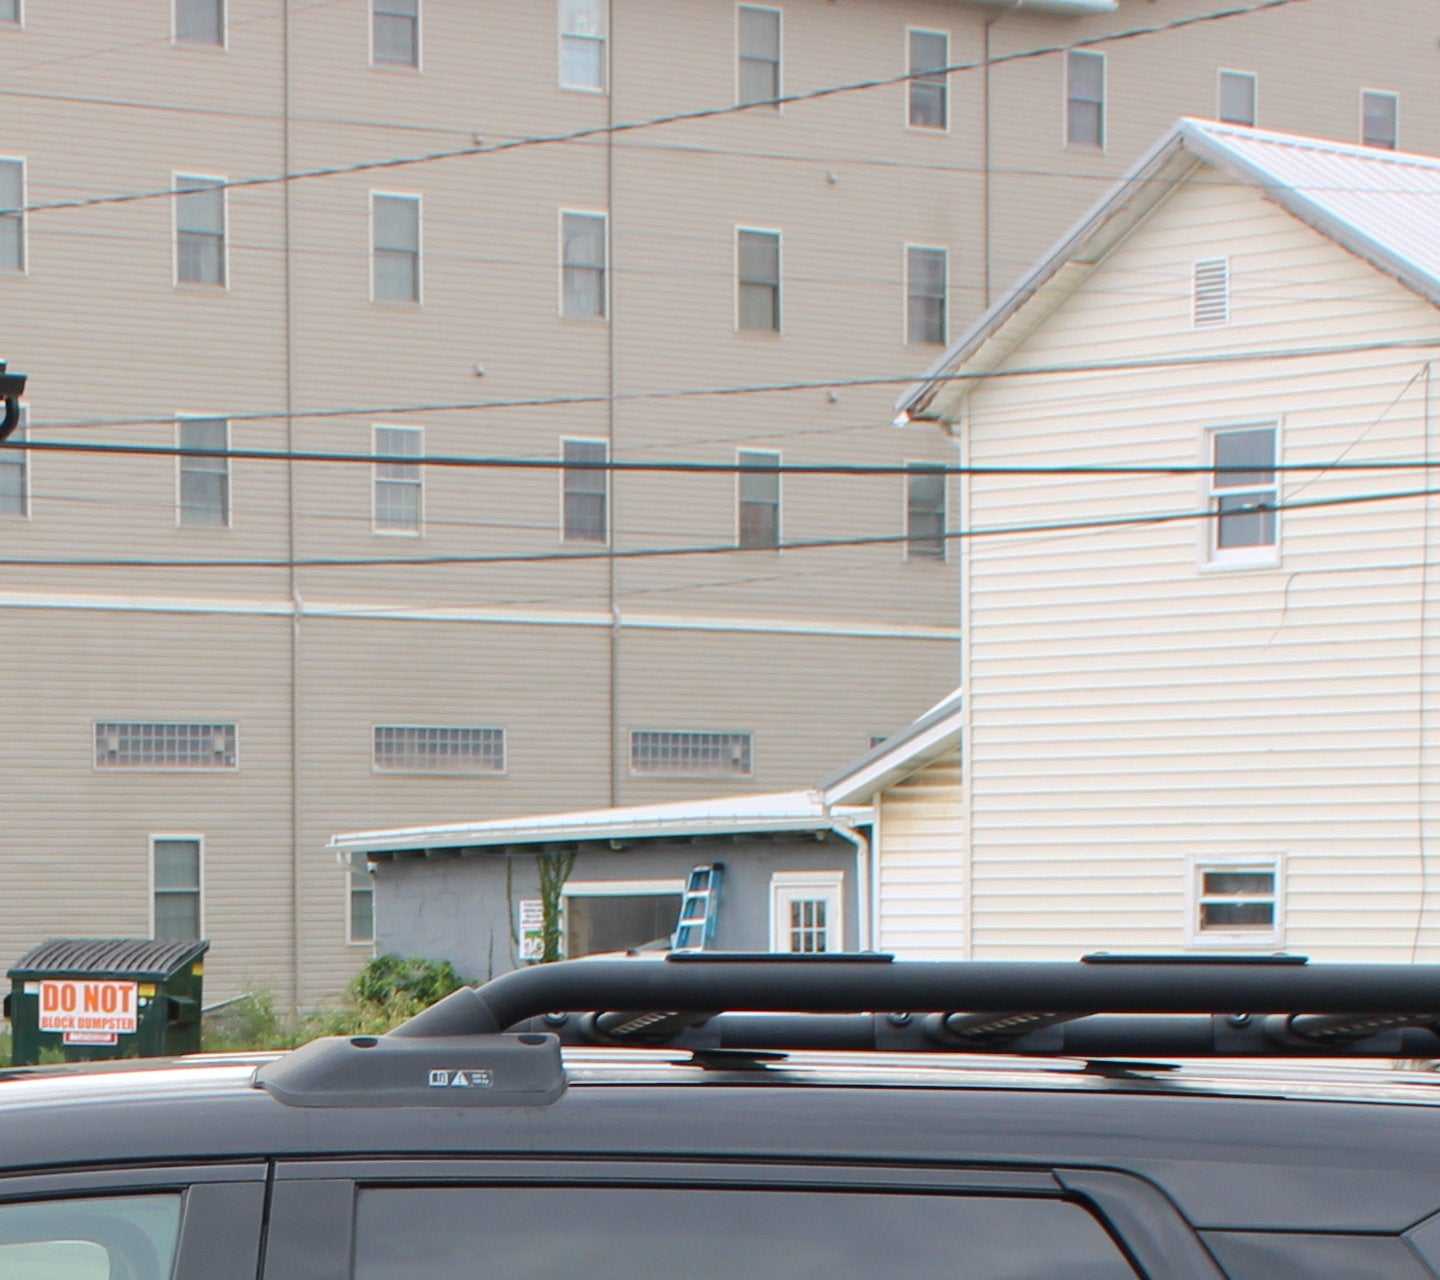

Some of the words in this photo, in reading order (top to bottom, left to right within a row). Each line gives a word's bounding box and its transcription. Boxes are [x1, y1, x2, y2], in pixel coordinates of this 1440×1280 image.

[43, 984, 76, 1012] DO
[84, 985, 134, 1012] NOT
[42, 1017, 76, 1028] BLOCK
[78, 1017, 134, 1030] DUMPSTER
